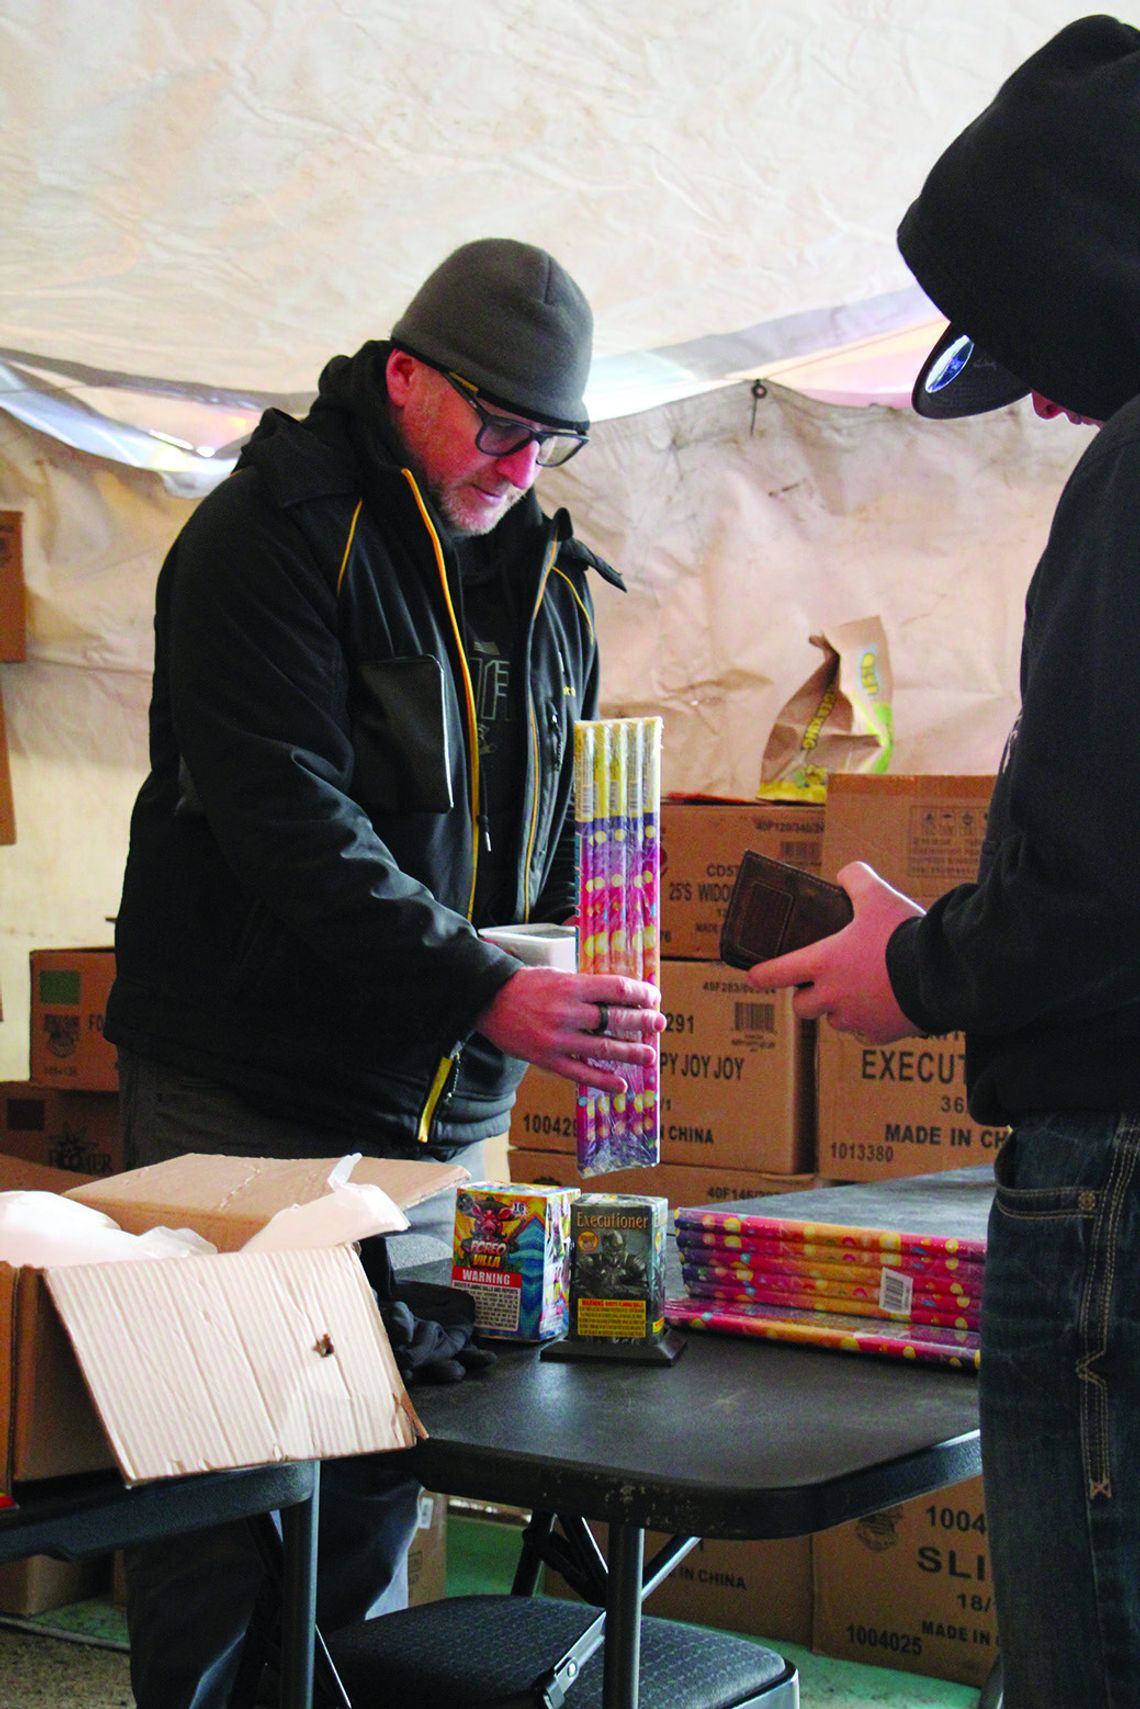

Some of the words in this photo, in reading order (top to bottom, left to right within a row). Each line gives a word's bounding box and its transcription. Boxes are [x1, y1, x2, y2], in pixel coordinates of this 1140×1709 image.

[681, 1053, 712, 1079] JOY
[714, 1056, 745, 1081] JOY
[668, 1125, 715, 1144] CHINA
[884, 1123, 942, 1146] MADE
[951, 1127, 972, 1147] IN
[831, 1142, 895, 1163] 1013380
[513, 1202, 526, 1214] 16
[576, 1211, 649, 1230] Executioner
[472, 1252, 502, 1270] VILLA
[461, 1268, 511, 1286] WARNING
[926, 1504, 987, 1535] 1004
[917, 1545, 986, 1582] SLI
[697, 1567, 748, 1591] CHINA
[846, 1623, 923, 1656] 1004025
[920, 1620, 969, 1643] MADE
[972, 1628, 992, 1646] IN
